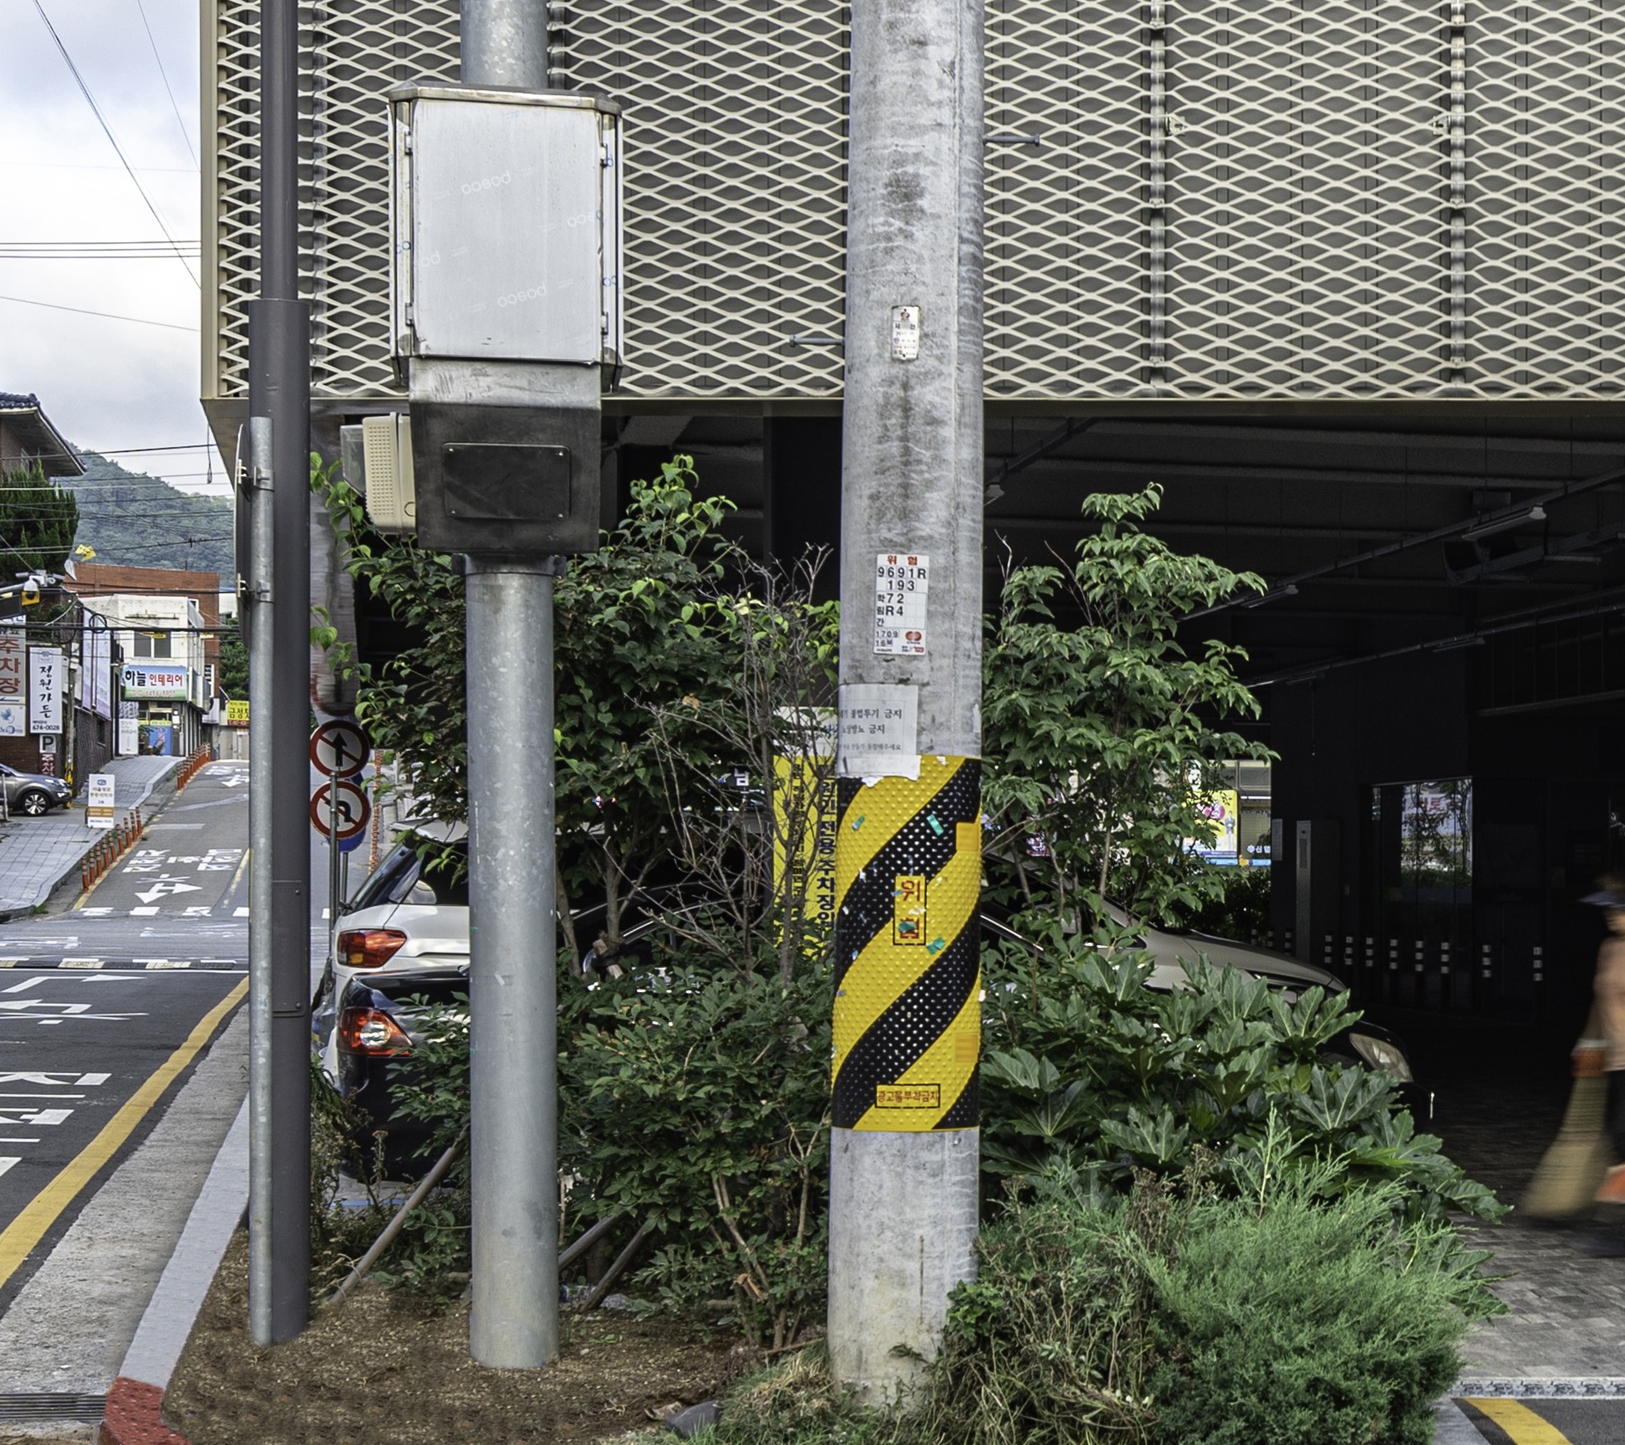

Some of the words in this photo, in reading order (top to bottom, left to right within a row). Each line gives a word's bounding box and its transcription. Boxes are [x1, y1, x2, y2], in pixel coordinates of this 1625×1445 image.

[887, 555, 918, 566] 위험
[878, 567, 926, 579] 9691R
[888, 580, 915, 591] 193
[887, 593, 904, 604] 72
[886, 606, 904, 616] R4
[876, 631, 898, 639] 1709
[125, 670, 146, 686] 하늘
[149, 674, 183, 687] 인테리어
[39, 665, 53, 719] 정원가든
[884, 709, 902, 719] 금지
[868, 724, 885, 734] 금지
[42, 736, 54, 750] P
[877, 1090, 939, 1102] 광고물부착금지
